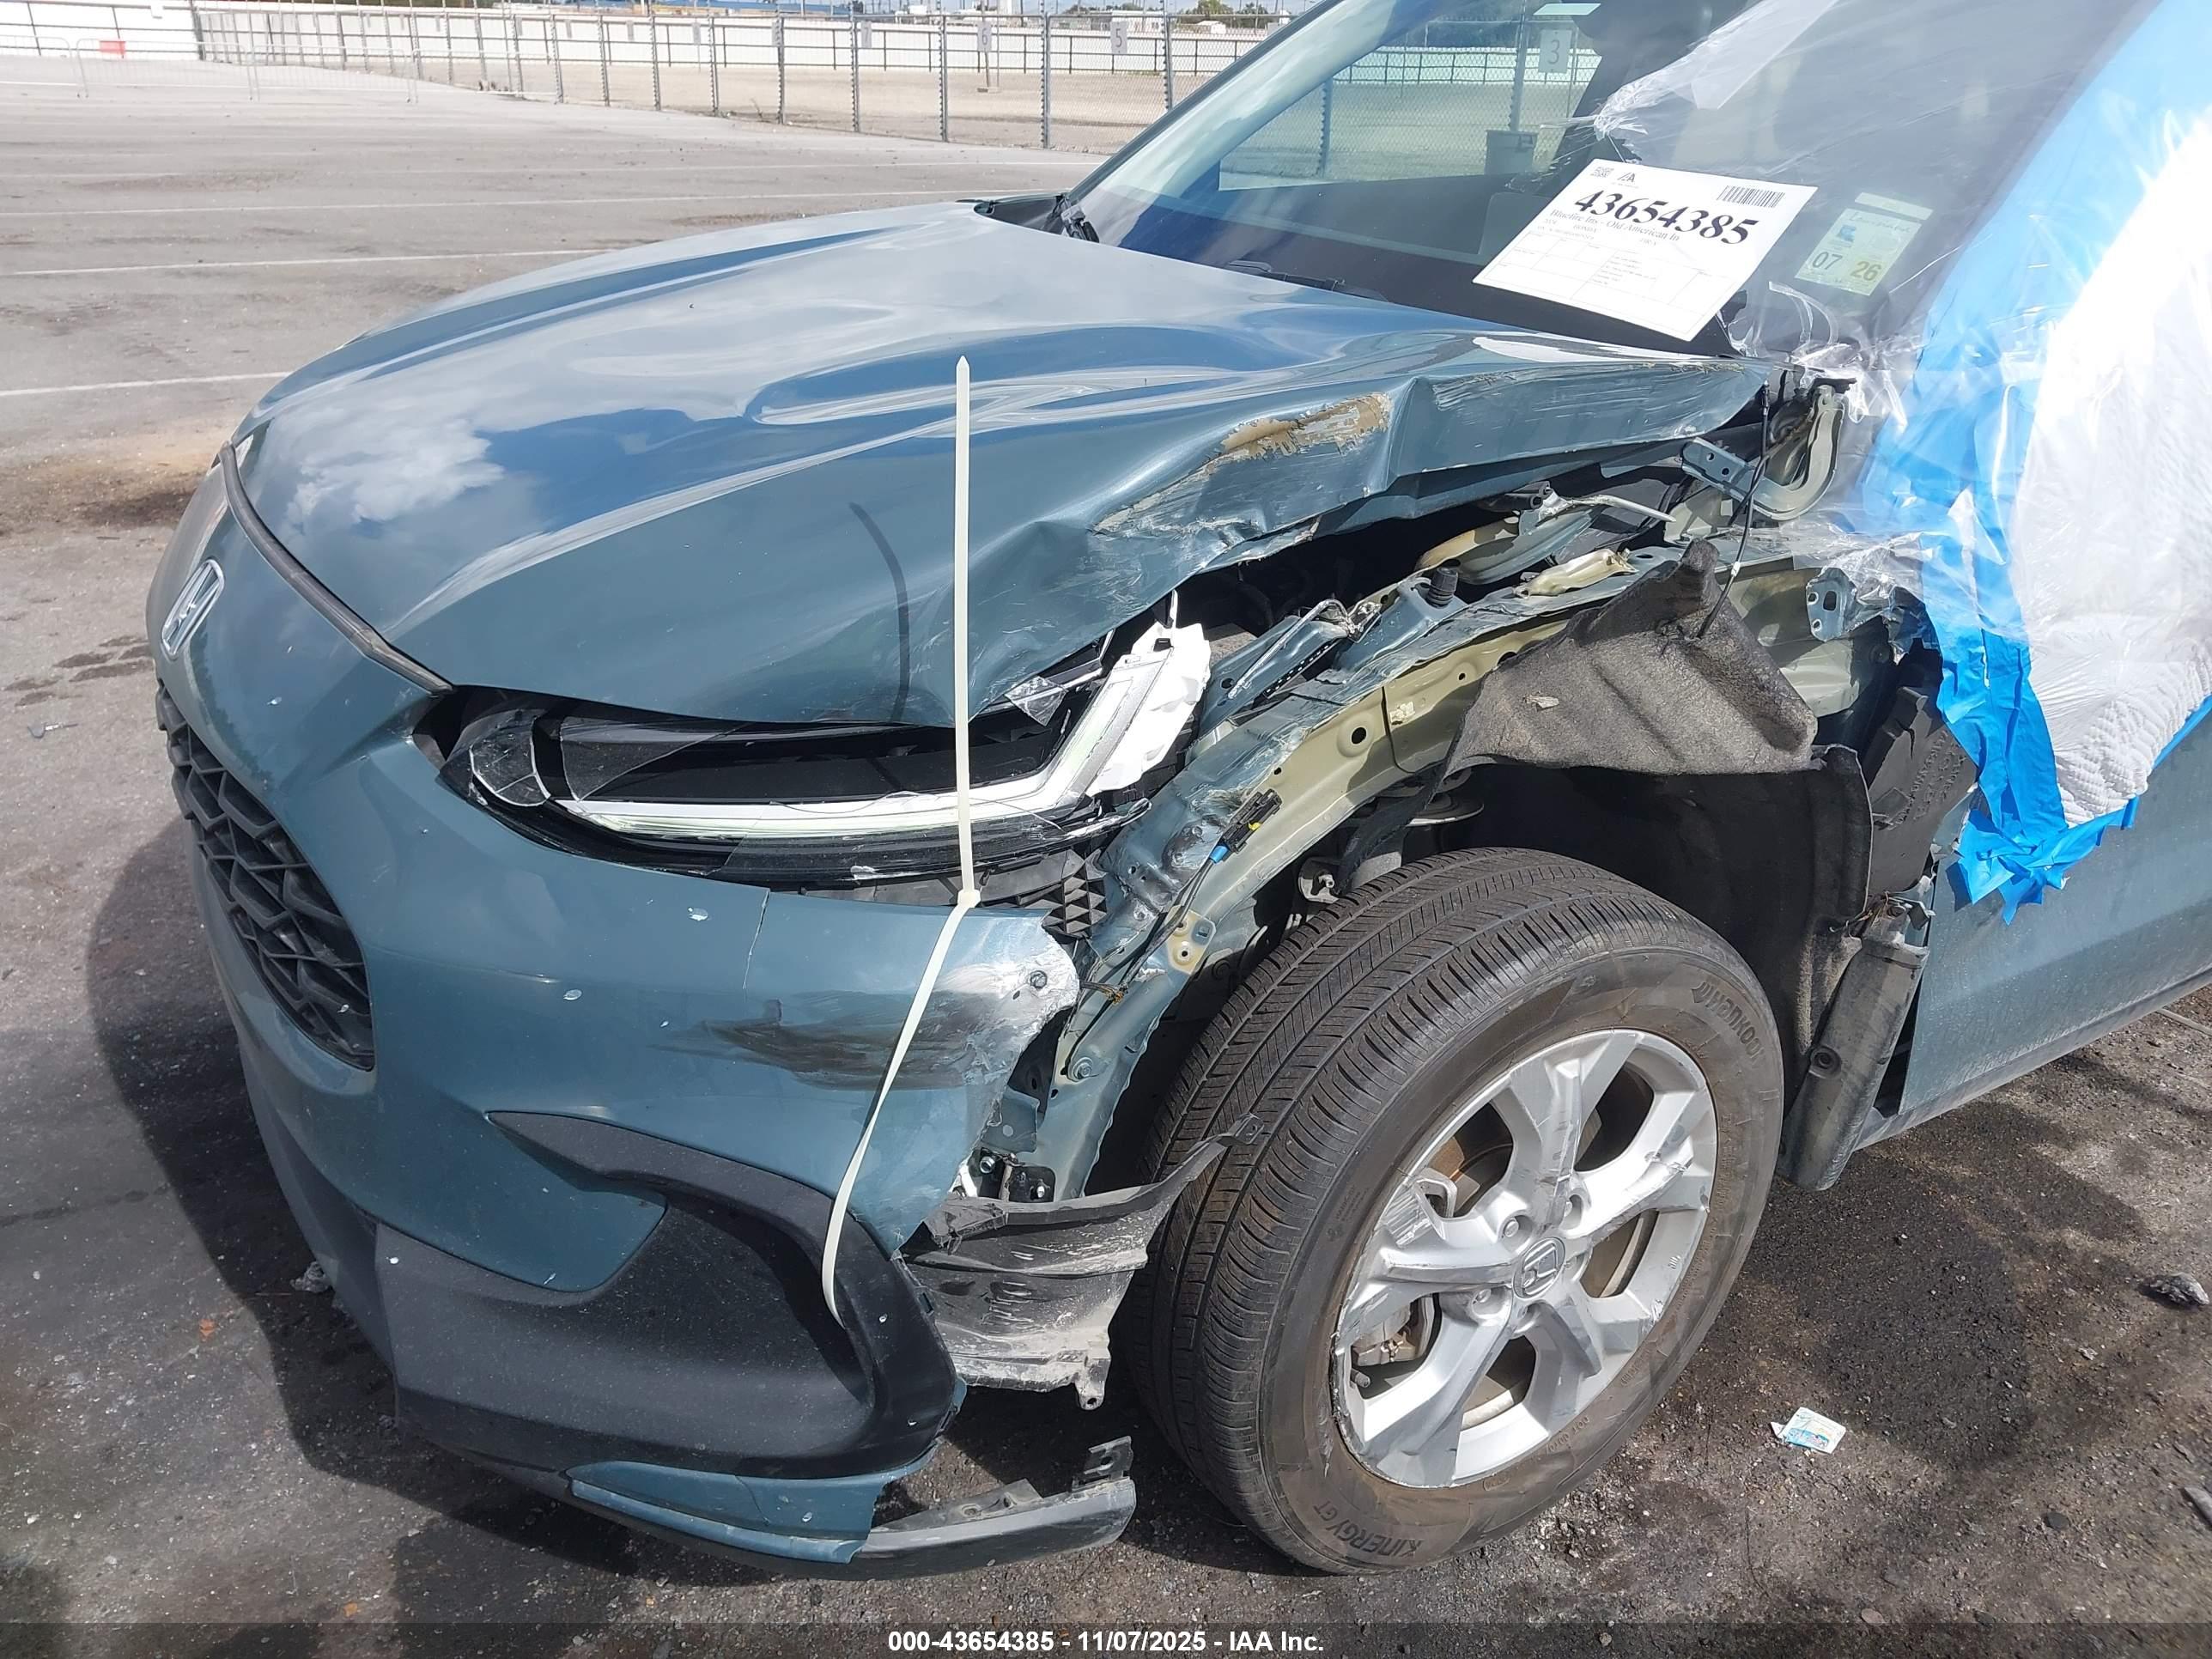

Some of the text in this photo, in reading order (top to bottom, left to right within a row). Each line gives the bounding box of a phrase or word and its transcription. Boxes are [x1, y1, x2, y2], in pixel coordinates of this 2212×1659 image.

[981, 27, 988, 46] 6
[1115, 28, 1122, 47] 5
[1547, 40, 1560, 64] 3
[1550, 209, 1582, 222] Bluefire
[1607, 220, 1624, 230] Old
[1624, 224, 1668, 240] American
[1575, 190, 1759, 244] 43654385
[1812, 252, 1844, 270] 07
[1850, 261, 1882, 281] 26
[1312, 1501, 1425, 1558] KINERGY GT
